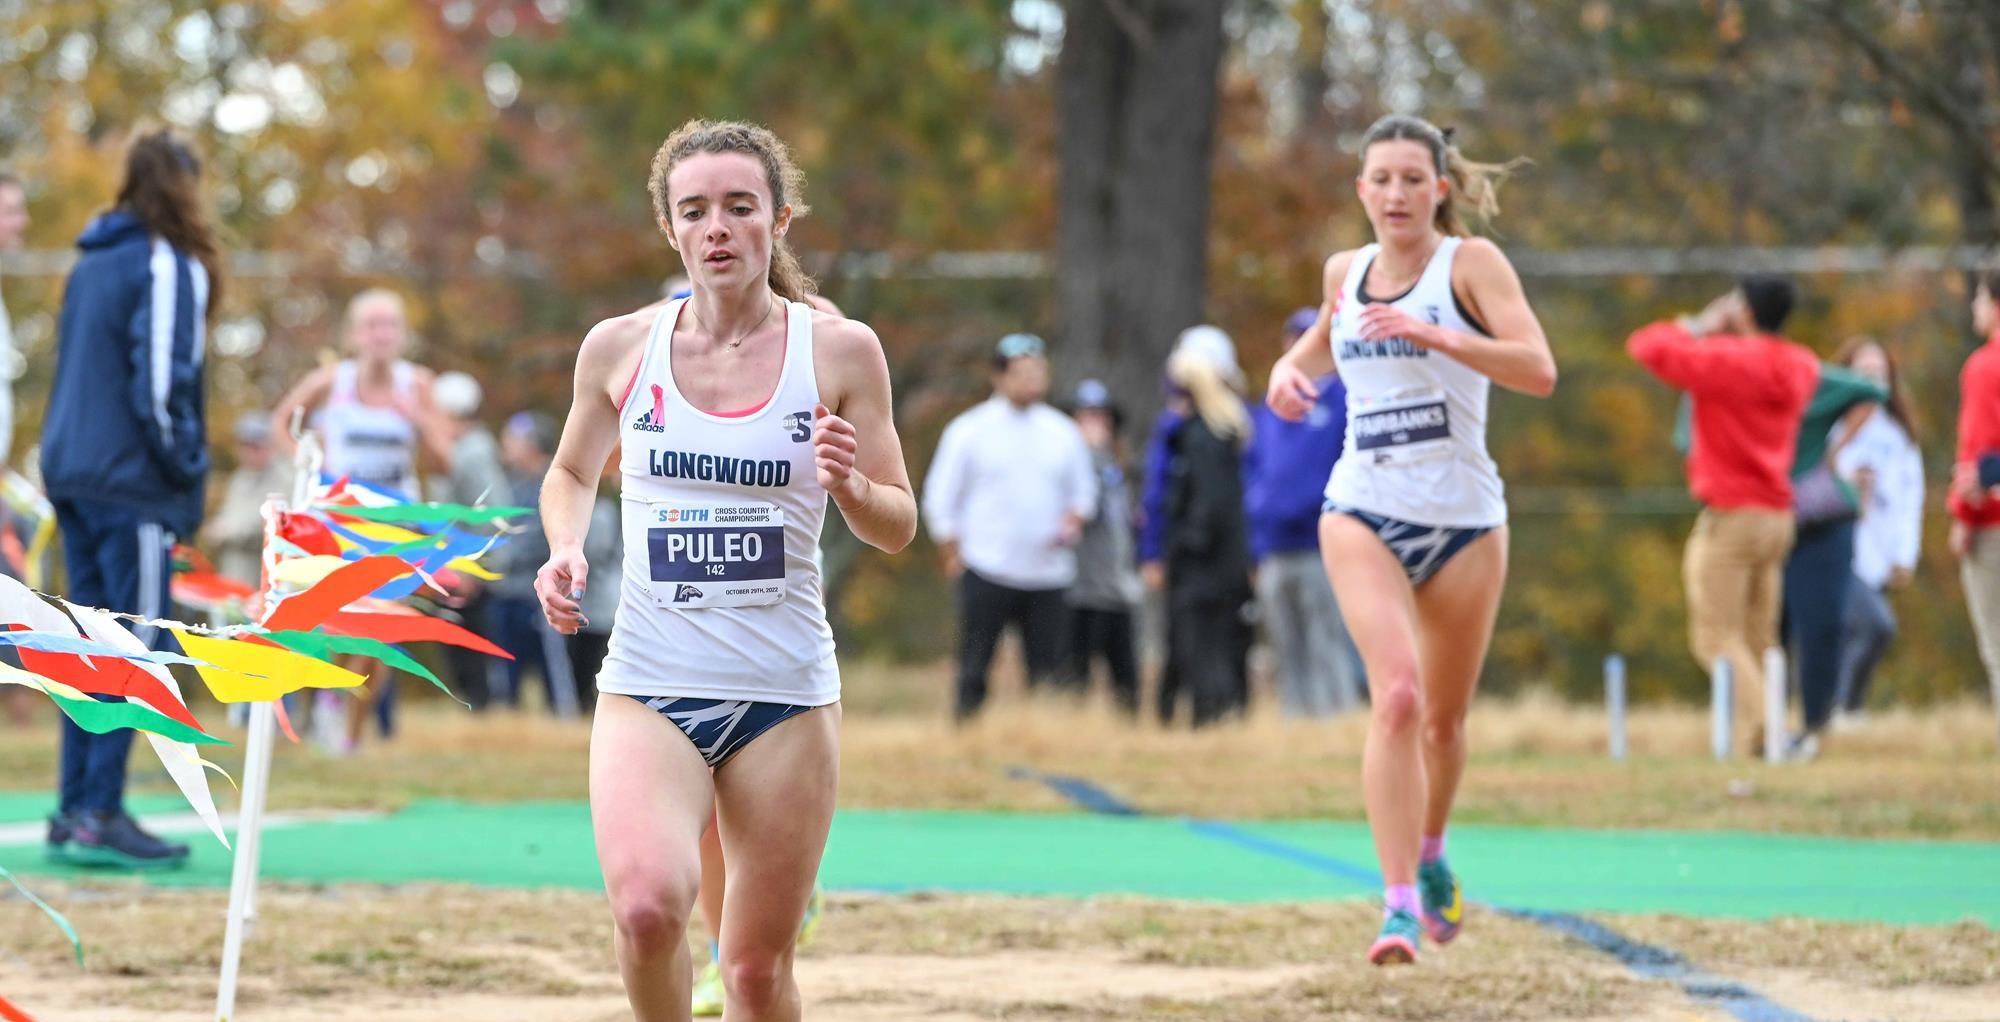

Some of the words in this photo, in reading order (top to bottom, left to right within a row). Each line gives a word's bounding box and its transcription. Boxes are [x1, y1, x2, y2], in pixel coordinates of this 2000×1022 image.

[633, 421, 665, 433] adidas
[792, 411, 811, 443] S
[1356, 406, 1444, 438] FAIRBANKS
[649, 449, 791, 487] LONGWOOD
[658, 508, 709, 522] SOUTH
[715, 507, 738, 515] CROSS
[738, 507, 770, 515] COUNTRY
[715, 515, 770, 523] CHAMPIONSHIPS
[667, 532, 763, 563] PULEO
[705, 564, 726, 576] 142
[725, 588, 750, 596] OCTOBER
